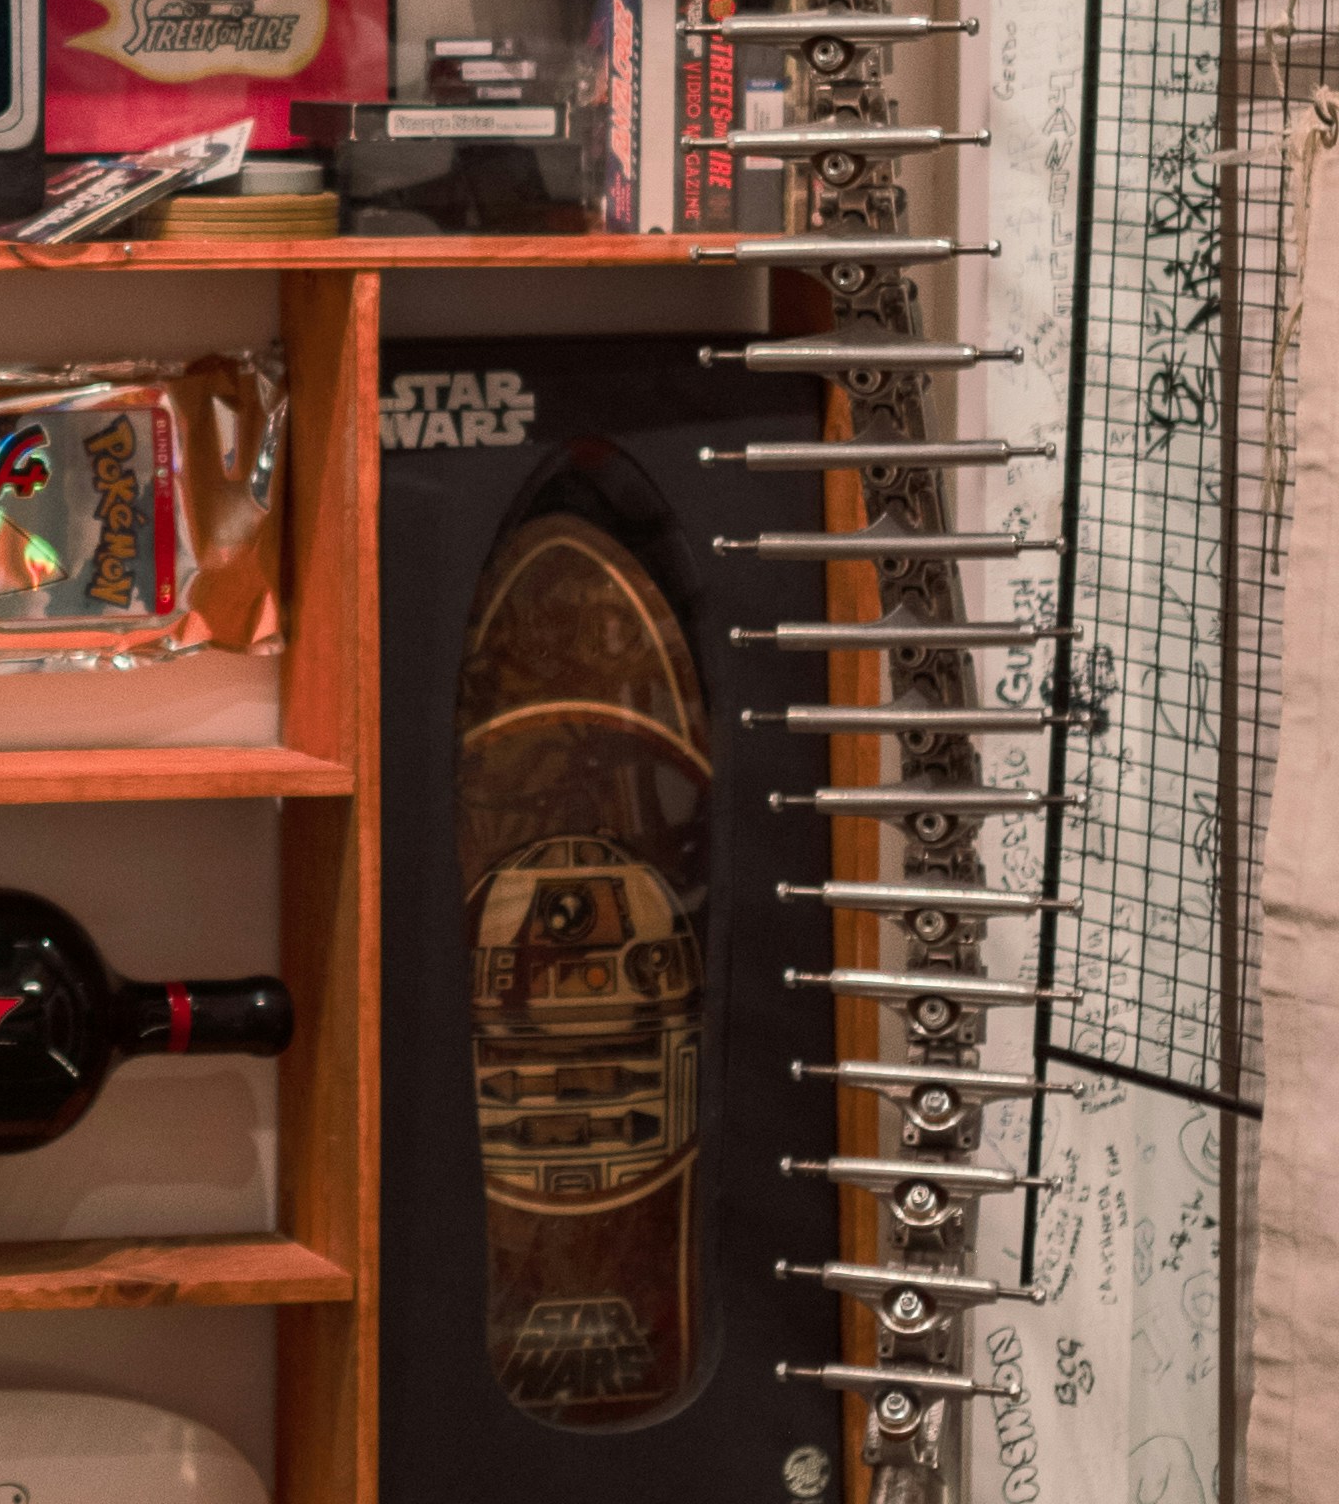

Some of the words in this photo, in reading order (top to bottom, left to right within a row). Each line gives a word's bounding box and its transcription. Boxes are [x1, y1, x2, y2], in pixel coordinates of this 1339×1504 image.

[234, 13, 301, 54] FIRE
[683, 62, 703, 120] VIDEO
[682, 124, 703, 220] MGAZINE
[379, 370, 535, 412] STAR
[156, 419, 169, 465] BLIND
[379, 409, 535, 450] WARS
